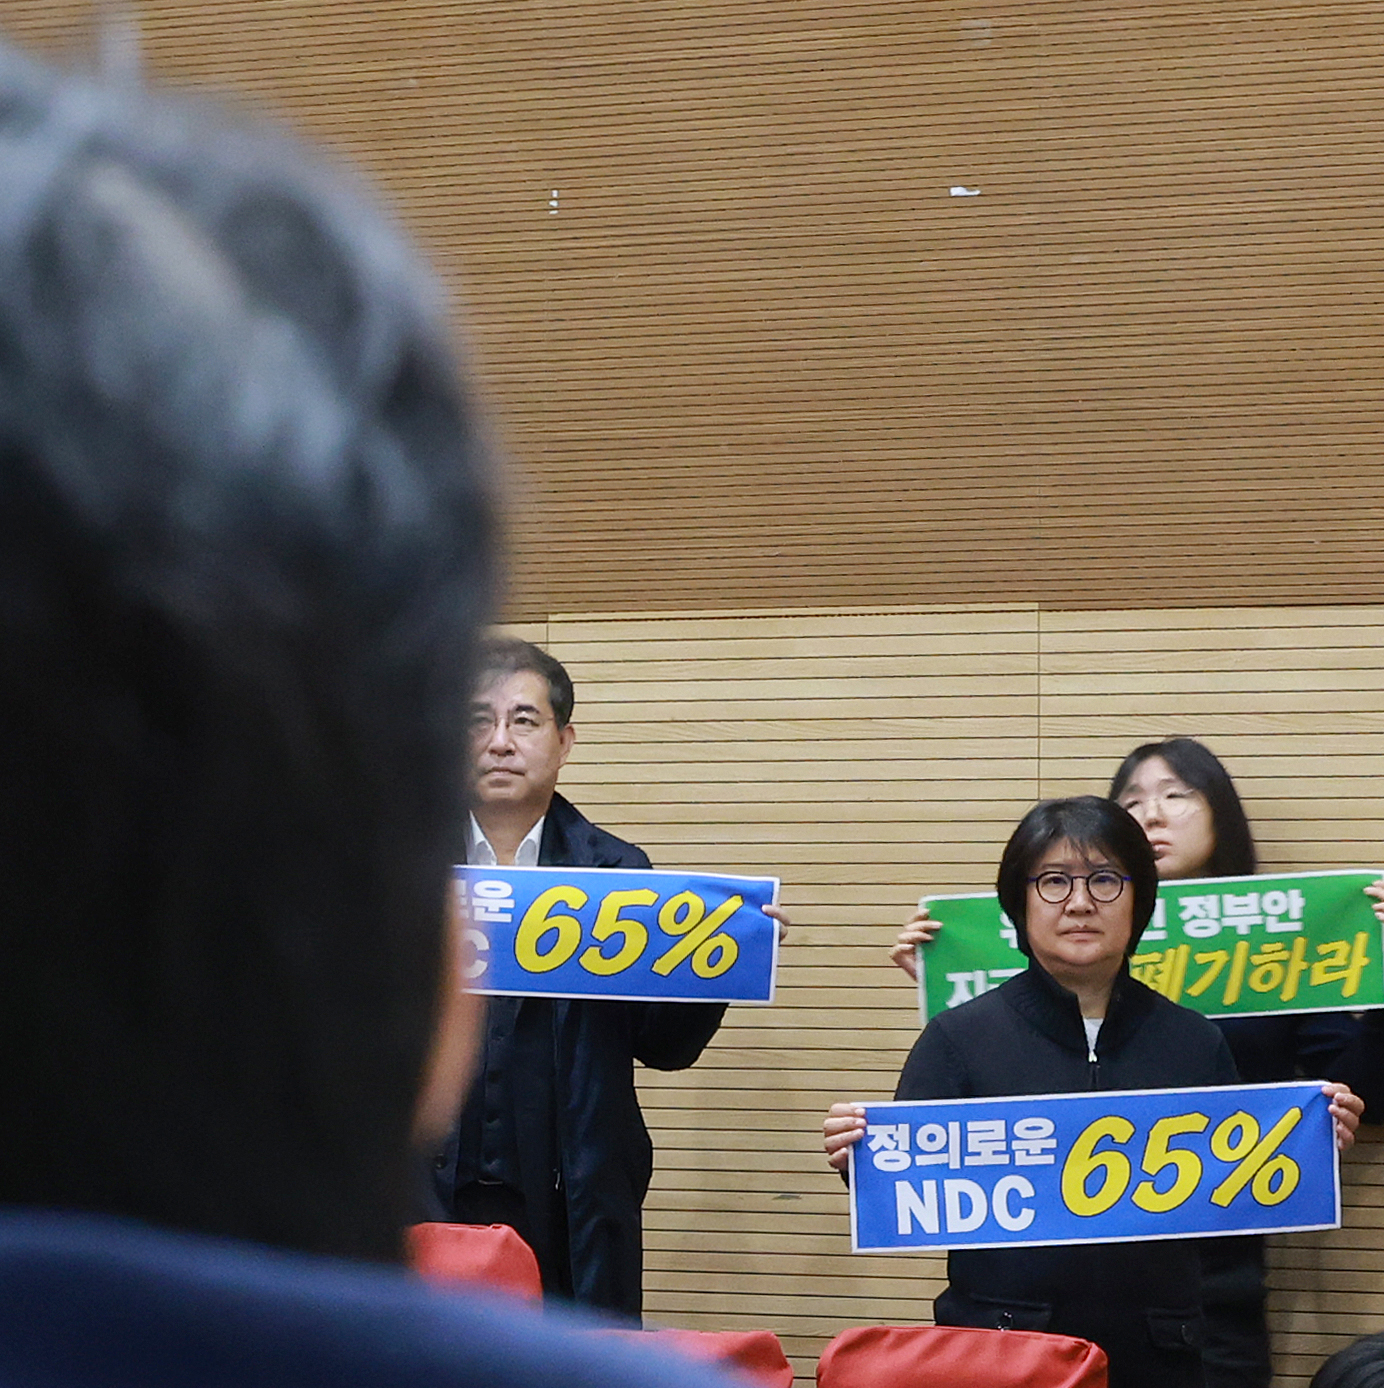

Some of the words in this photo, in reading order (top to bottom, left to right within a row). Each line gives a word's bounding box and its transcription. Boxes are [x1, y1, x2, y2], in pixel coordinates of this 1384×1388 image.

[514, 884, 744, 979] 65%
[1177, 889, 1305, 940] 정부안
[866, 1118, 1057, 1172] 정의로운
[1060, 1106, 1303, 1217] 65%
[896, 1175, 1035, 1235] NDC
